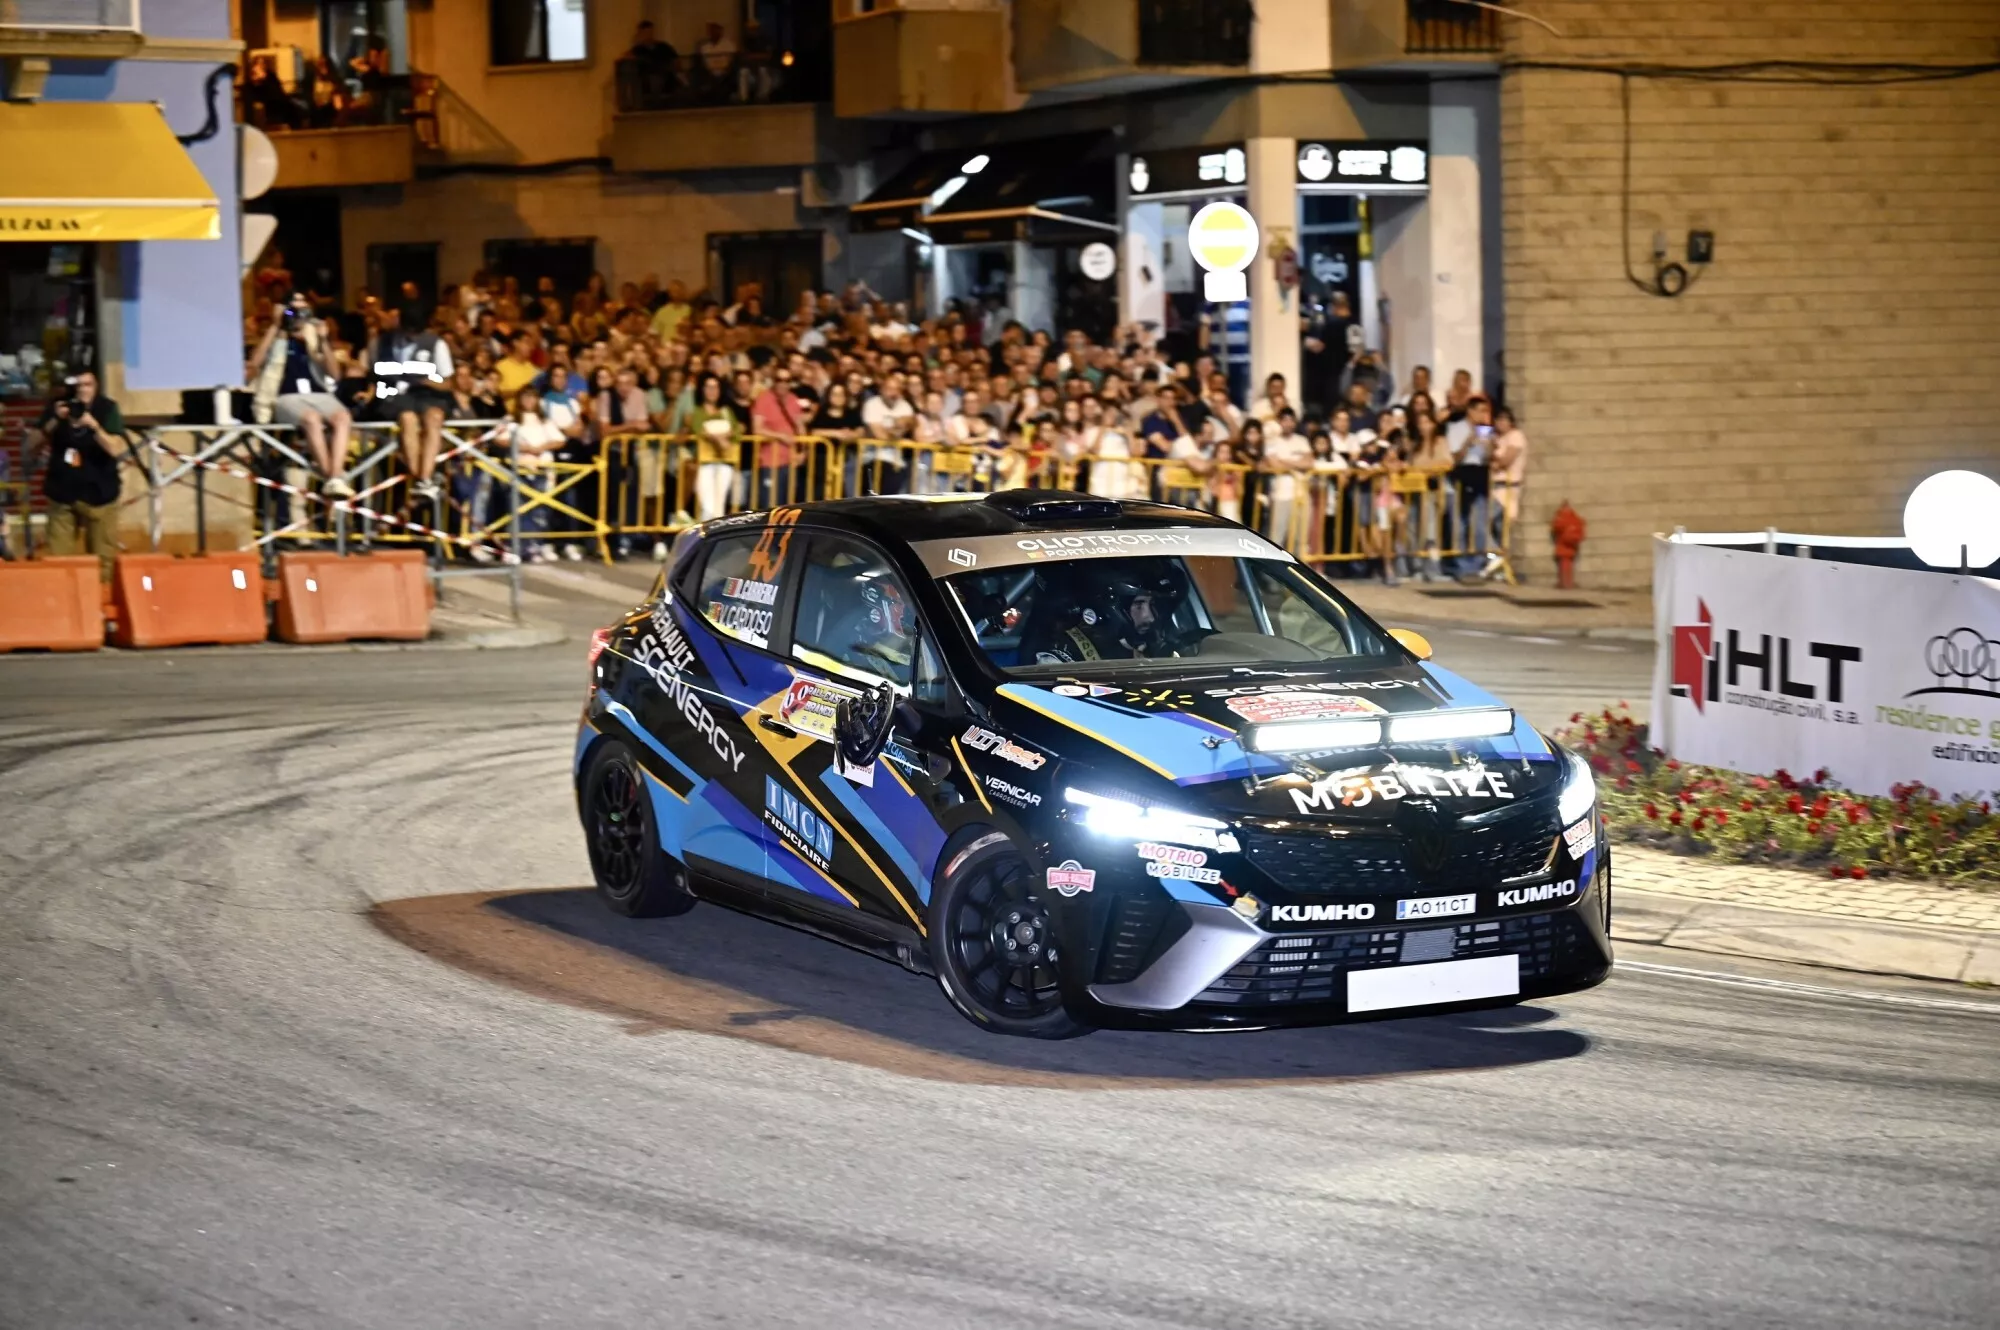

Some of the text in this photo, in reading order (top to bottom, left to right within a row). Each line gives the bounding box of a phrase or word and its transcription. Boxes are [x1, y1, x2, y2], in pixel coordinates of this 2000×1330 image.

[748, 509, 802, 583] 43
[1045, 545, 1128, 558] PORTUGAL
[652, 602, 695, 671] RENAULT
[1727, 629, 1862, 703] HLT
[633, 634, 745, 772] SCENERGY
[1204, 679, 1420, 698] SCENERGY
[1875, 704, 1982, 737] residence
[985, 774, 1042, 806] VERNICAR
[1288, 771, 1515, 815] MOBILIZE
[769, 781, 831, 855] IMCN
[764, 809, 831, 872] FIDUCIAIRE
[1140, 843, 1205, 866] MOTRIO
[1148, 864, 1219, 883] MOBILIZE
[1497, 878, 1576, 907] KUMHO
[1271, 903, 1376, 921] KUMHO
